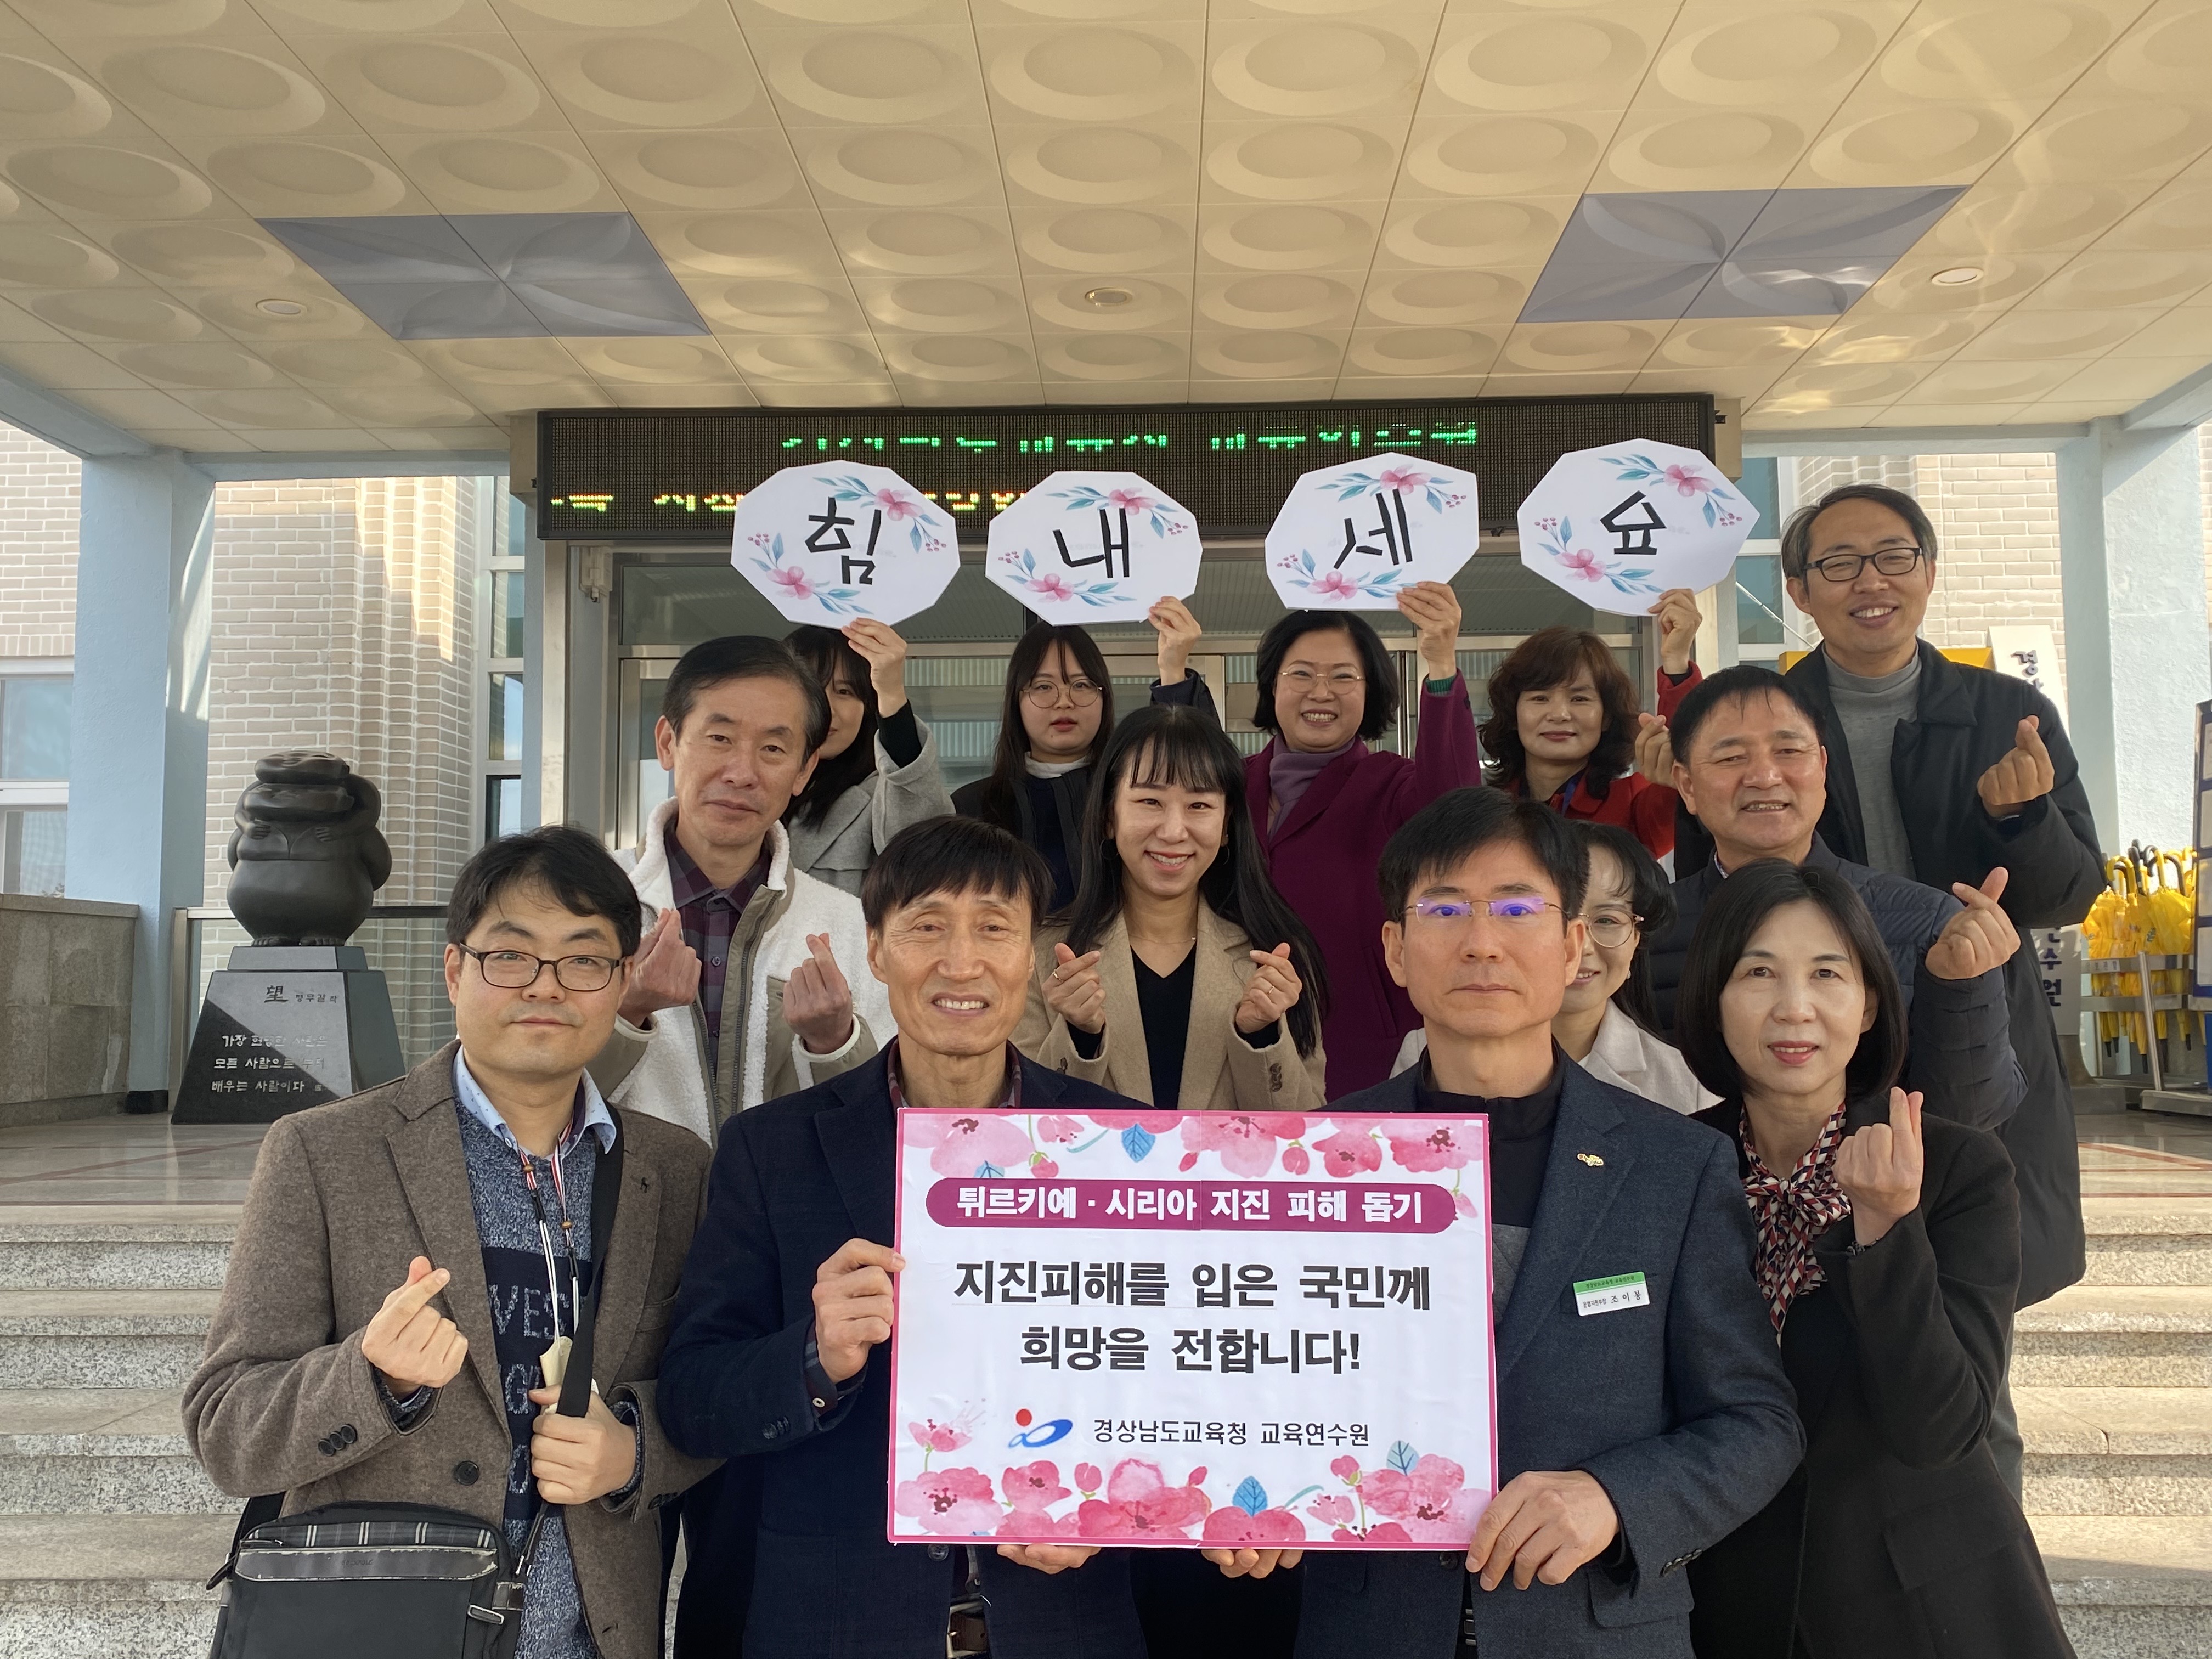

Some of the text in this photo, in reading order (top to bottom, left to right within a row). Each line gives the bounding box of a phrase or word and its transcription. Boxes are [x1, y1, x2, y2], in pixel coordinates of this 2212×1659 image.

[805, 497, 881, 585] 힘
[1053, 508, 1129, 578] 내
[1334, 488, 1412, 569] 세
[1600, 491, 1666, 555] 요
[263, 985, 289, 1003] 望
[222, 1034, 247, 1047] 가장
[213, 1058, 238, 1069] 모든
[211, 1080, 248, 1093] 배우는
[255, 1080, 305, 1093] 사람이다
[957, 1186, 1076, 1219] 튀르키예
[1105, 1188, 1197, 1221] 시리아
[1210, 1188, 1271, 1221] 지진
[1287, 1189, 1347, 1222] 피해
[1361, 1192, 1421, 1223] 돕기
[954, 1260, 1430, 1310] 지진피해를 입은 국민께
[1020, 1326, 1359, 1374] 희망을 전합니다!
[1094, 1419, 1369, 1447] 경상남도교육청 교육연수원
